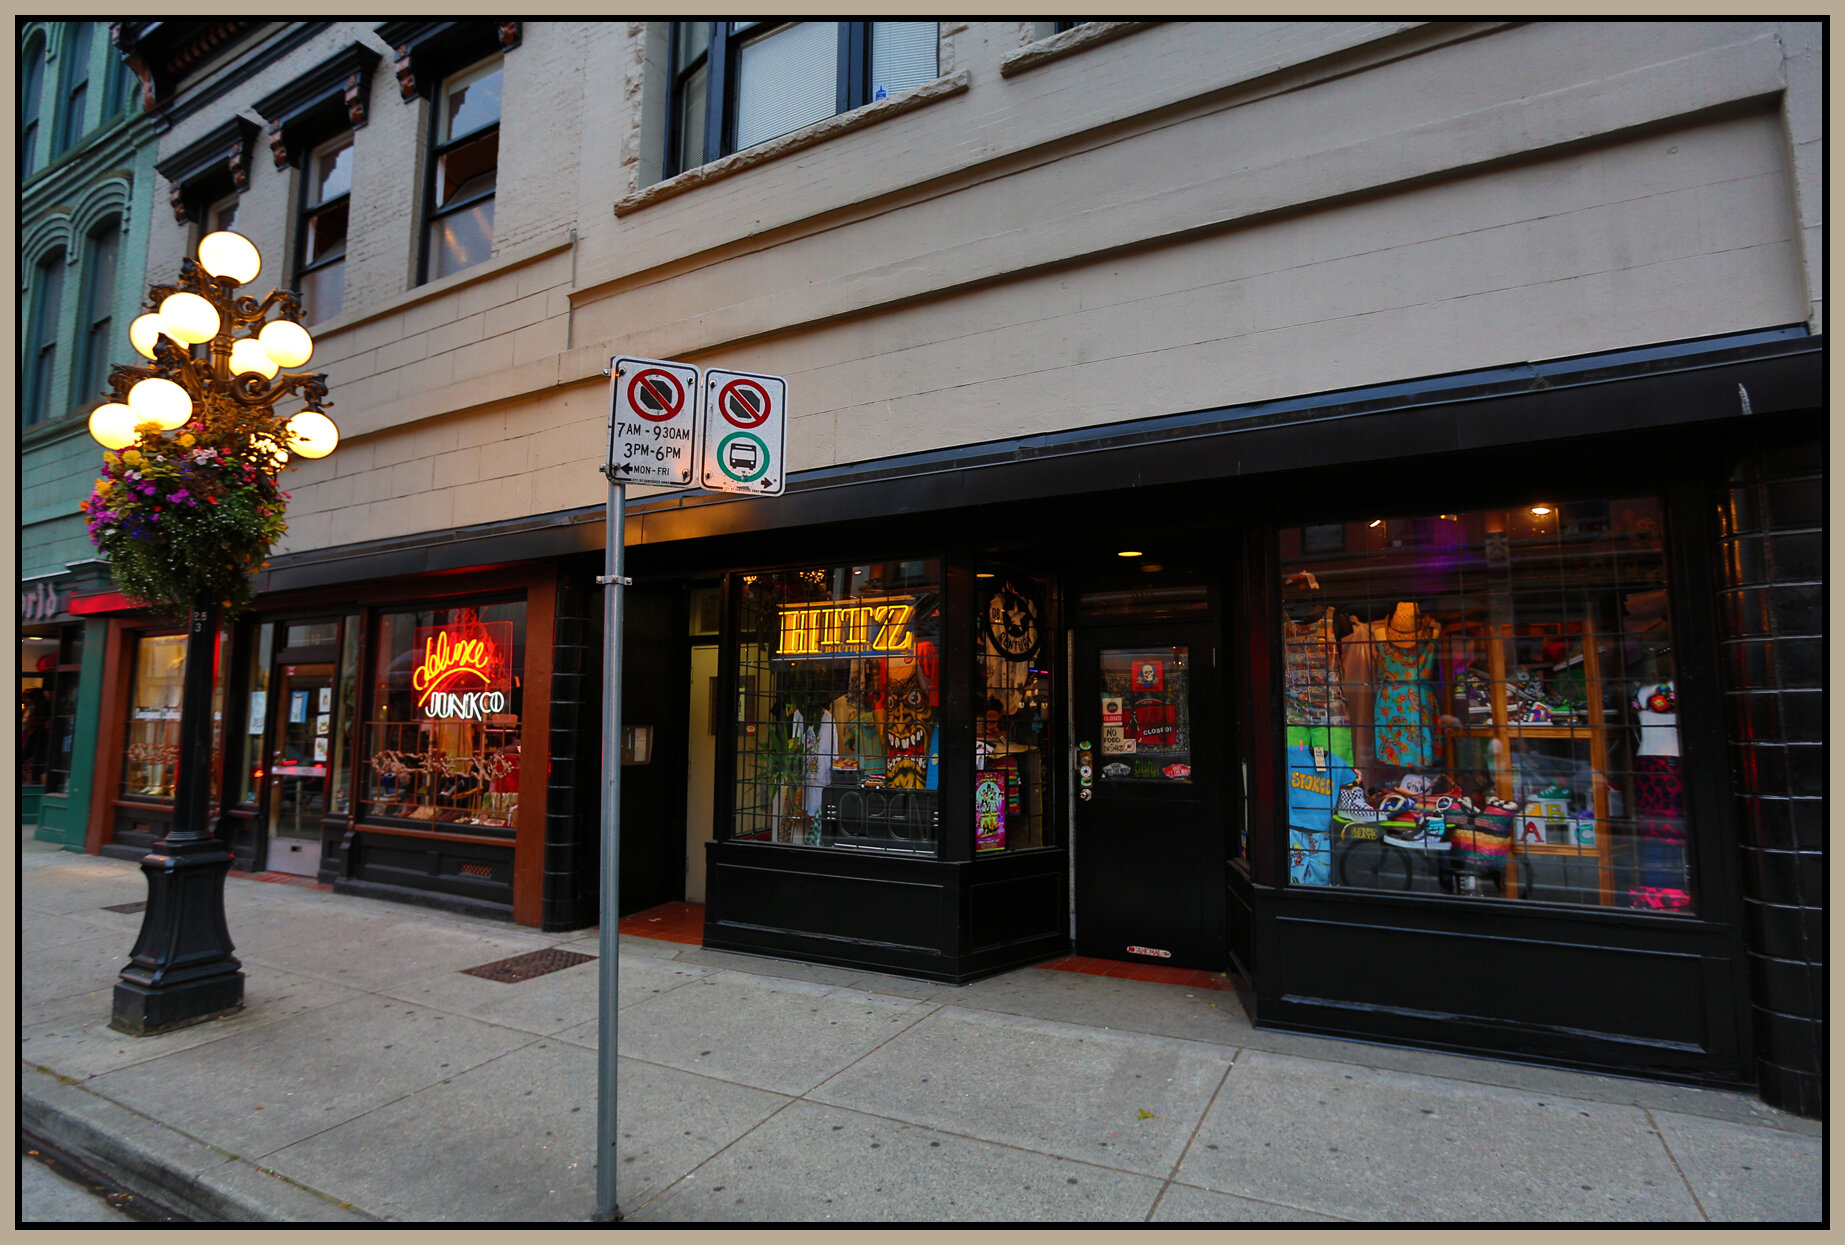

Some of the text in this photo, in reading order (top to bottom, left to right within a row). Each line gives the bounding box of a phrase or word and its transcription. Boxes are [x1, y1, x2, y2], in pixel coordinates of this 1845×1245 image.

[617, 422, 642, 438] 7AM
[195, 622, 202, 633] 3
[776, 605, 915, 653] HITZ
[824, 644, 872, 654] BOUTIQUE
[1106, 728, 1117, 737] NO
[1291, 771, 1333, 795] STOKED
[840, 791, 930, 843] OPEN
[1546, 804, 1567, 824] B
[1520, 821, 1545, 843] A
[1575, 824, 1595, 844] C
